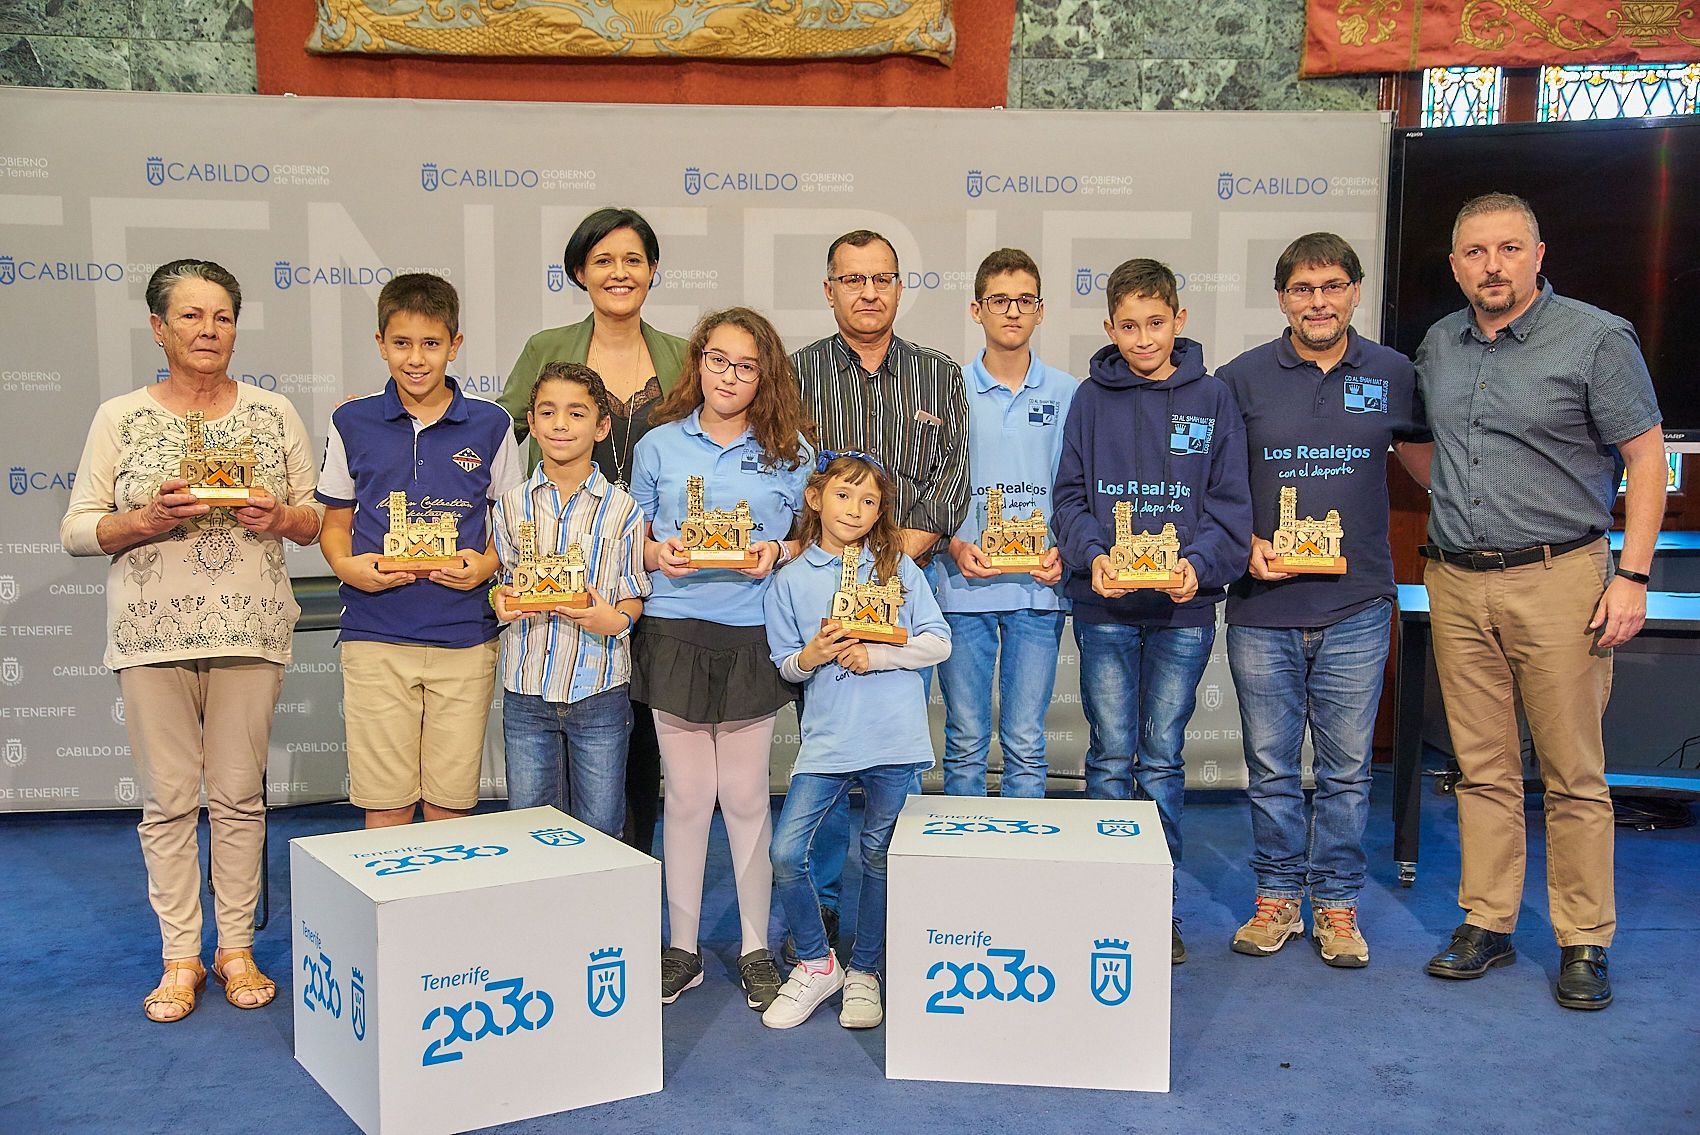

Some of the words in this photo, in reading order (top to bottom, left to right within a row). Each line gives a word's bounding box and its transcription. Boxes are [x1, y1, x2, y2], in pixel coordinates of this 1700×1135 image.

[0, 156, 48, 168] OBIERNO
[168, 162, 270, 184] CABILDO
[273, 164, 330, 175] GOBIERNO
[441, 168, 538, 188] CABILDO
[542, 170, 596, 180] GOBIERNO
[274, 176, 288, 186] de
[291, 175, 330, 186] Tenerife
[542, 180, 555, 189] de
[558, 180, 596, 190] Tenerife
[704, 172, 798, 190] CABILDO
[800, 173, 854, 182] GOBIERNO
[985, 175, 1078, 194] CABILDO
[1080, 176, 1133, 184] GOBIERNO
[801, 183, 814, 192] de
[817, 183, 854, 192] Tenerife
[1081, 185, 1094, 194] de
[1096, 186, 1133, 195] Tenerife
[1236, 177, 1328, 196] CABILDO
[1331, 188, 1344, 196] de
[18, 262, 124, 282] CABILDO
[294, 266, 394, 285] CABILDO
[664, 270, 718, 280] GOBIERNO
[944, 272, 976, 280] GOBIE
[1189, 273, 1240, 282] GOBIERNO
[666, 280, 678, 289] de
[681, 280, 718, 290] Tenerife
[1189, 283, 1202, 292] de
[1204, 283, 1240, 292] Tenerife
[2, 370, 61, 382] GOBIERNO
[280, 374, 336, 384] GOBIERNO
[3, 382, 18, 392] de
[21, 382, 61, 392] Tenerife
[281, 384, 296, 393] de
[298, 384, 336, 394] Tenerife
[451, 375, 504, 392] ABIL
[1264, 447, 1292, 460] Los
[1297, 445, 1371, 461] Realejos
[1279, 469, 1296, 478] con
[1299, 463, 1308, 477] el
[1311, 462, 1354, 480] deporte
[996, 482, 1047, 495] Realeos
[1098, 480, 1124, 495] Los
[1141, 500, 1183, 518] depote
[50, 584, 105, 595] CABILDO
[11, 626, 72, 636] TENERIFE
[52, 666, 108, 676] CABILDO
[1050, 694, 1080, 703] CABIL
[14, 706, 76, 717] TENERIFE
[1204, 730, 1220, 740] DE
[56, 746, 111, 757] CABILDO
[115, 746, 131, 756] DE
[286, 743, 338, 752] CABILDO
[18, 787, 80, 798] TENERIFE
[266, 782, 308, 792] NERIFE
[927, 812, 995, 820] Tenerife
[922, 819, 1061, 836] 2030
[365, 844, 510, 876] 2030
[302, 920, 322, 950] Tenerife
[926, 929, 992, 948] Tenerife
[420, 966, 490, 992] Tenerife
[926, 948, 1056, 1015] 2030
[303, 952, 342, 1020] 2030
[422, 976, 554, 1068] 2030
